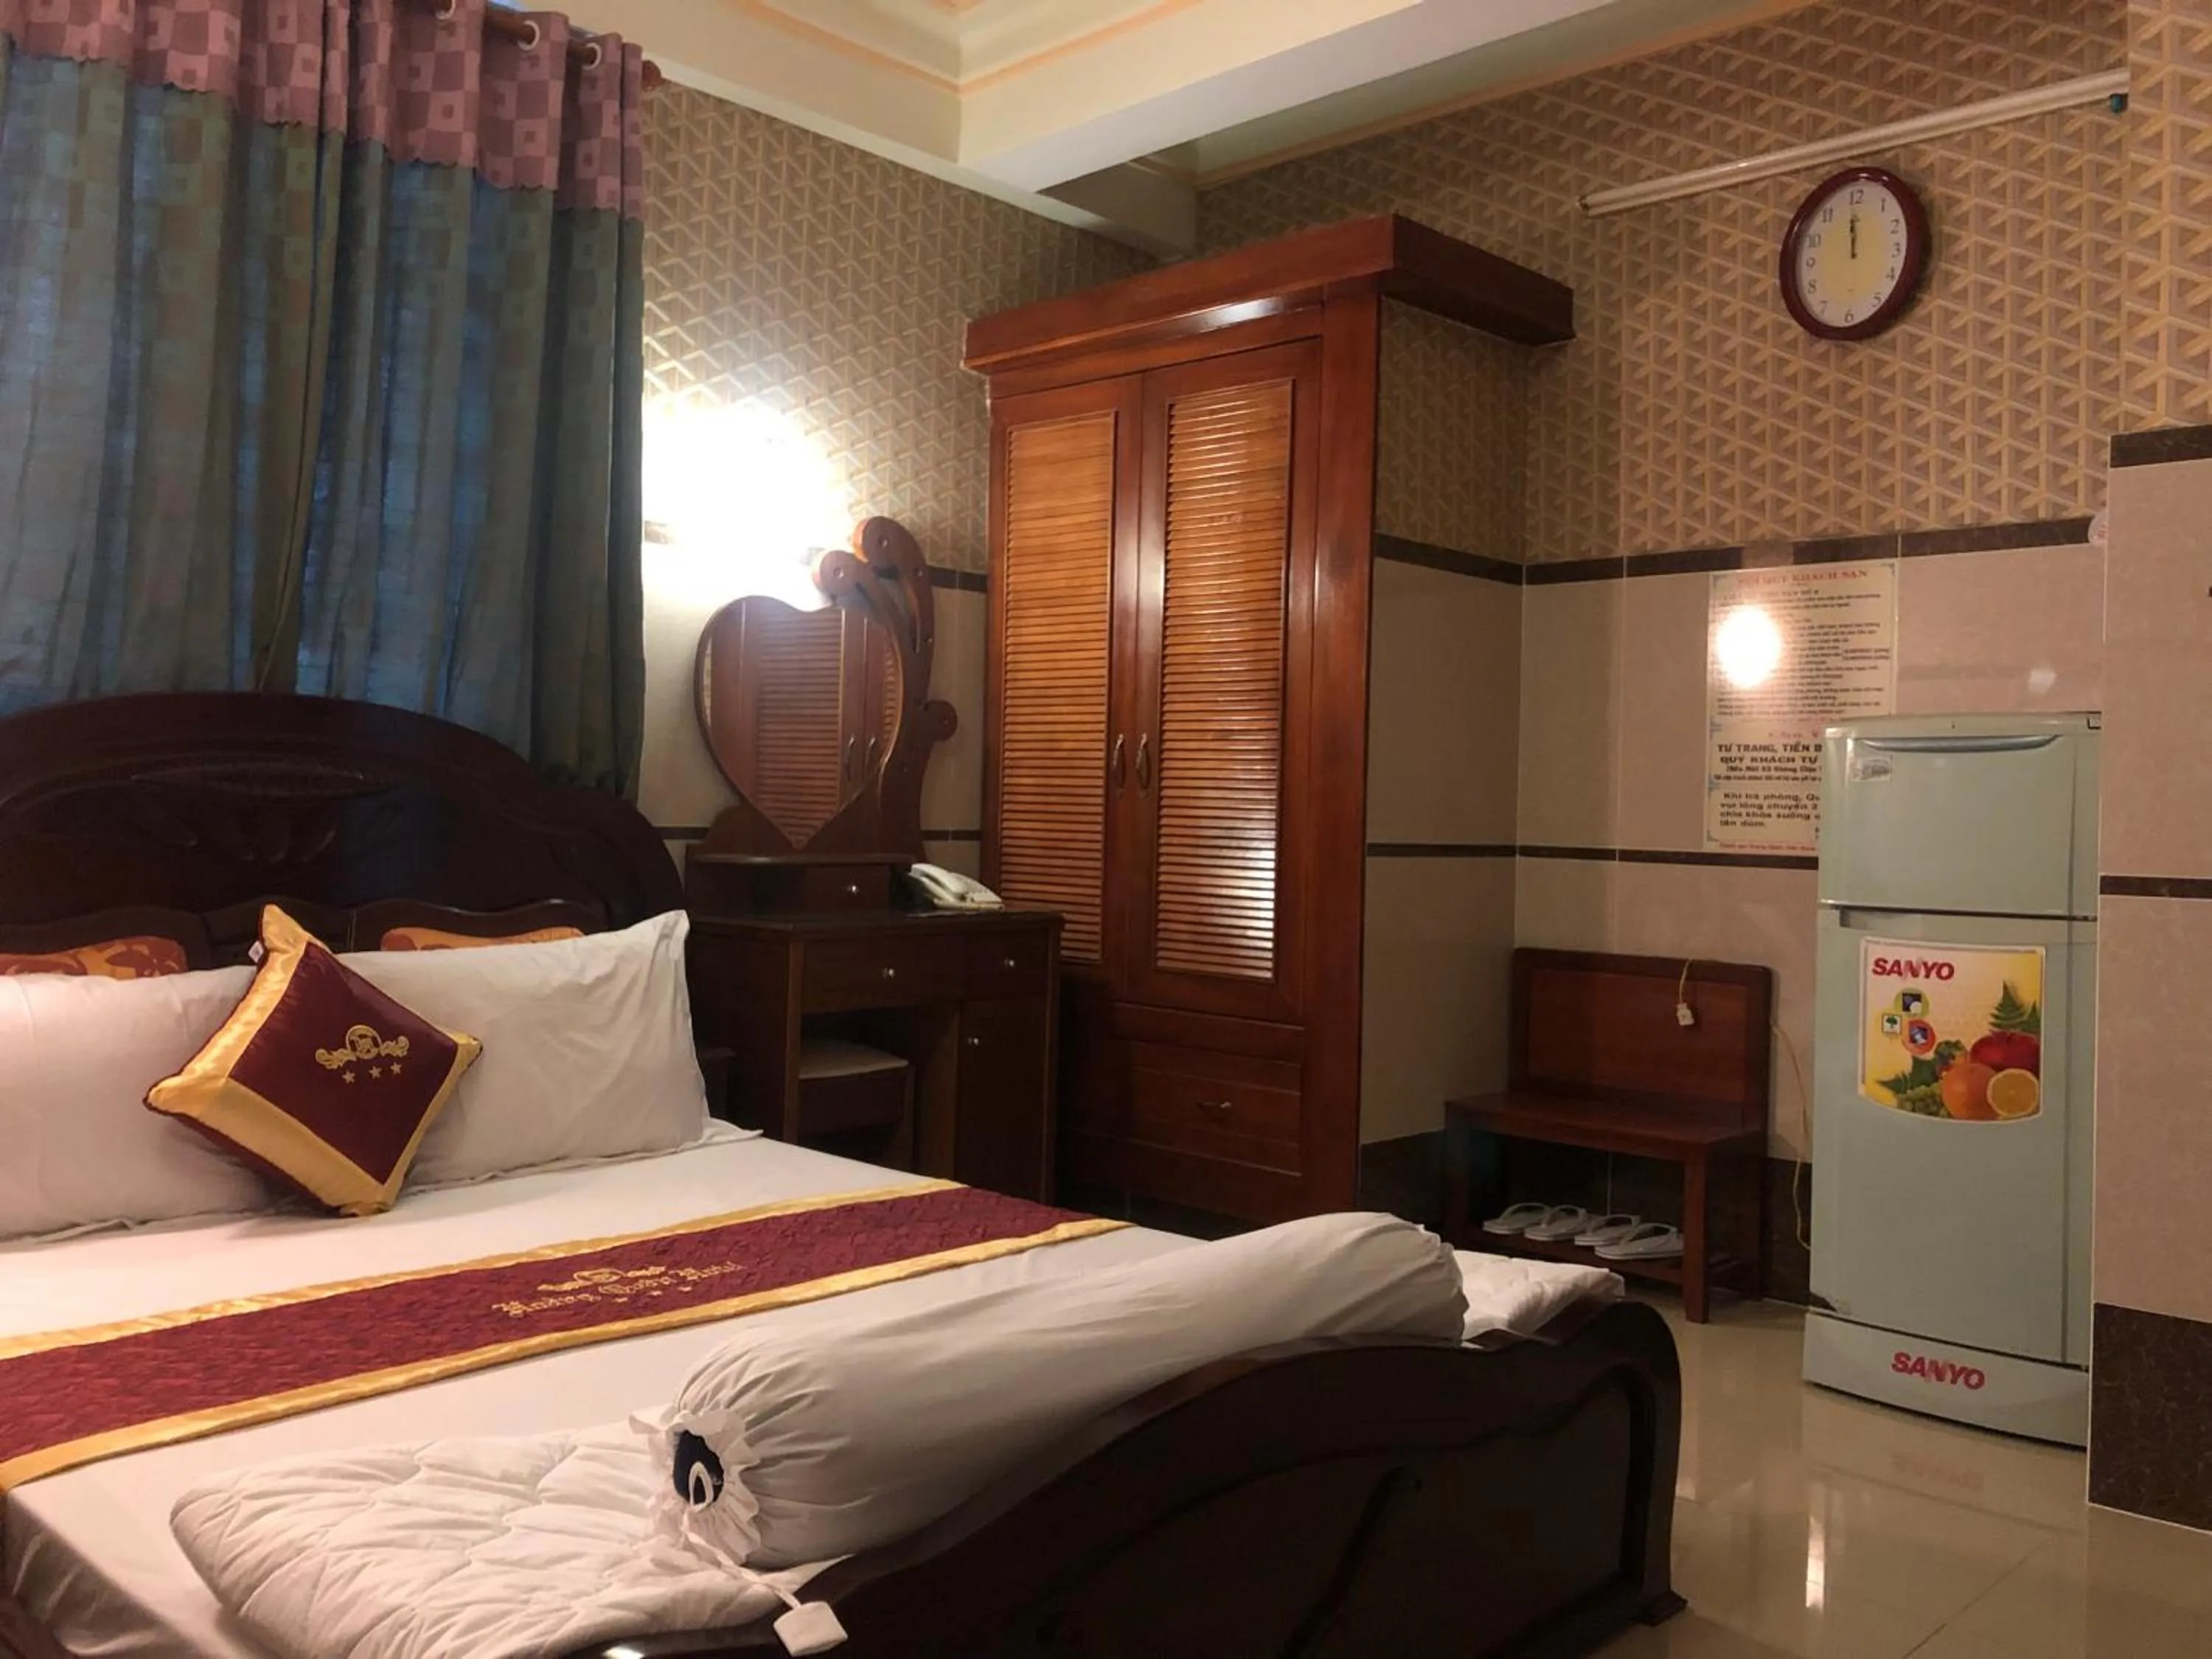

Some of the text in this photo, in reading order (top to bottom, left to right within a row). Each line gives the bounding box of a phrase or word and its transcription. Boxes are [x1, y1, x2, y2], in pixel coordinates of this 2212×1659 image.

[1849, 189, 1864, 206] 12
[1891, 218, 1900, 234] 2
[1891, 241, 1901, 258] 3
[1806, 257, 1815, 269] 9
[1807, 279, 1817, 294] 8
[1872, 292, 1882, 308] 5
[1844, 308, 1854, 324] 6
[1872, 957, 1955, 981] SANYO
[1891, 1352, 1986, 1391] SANYO
